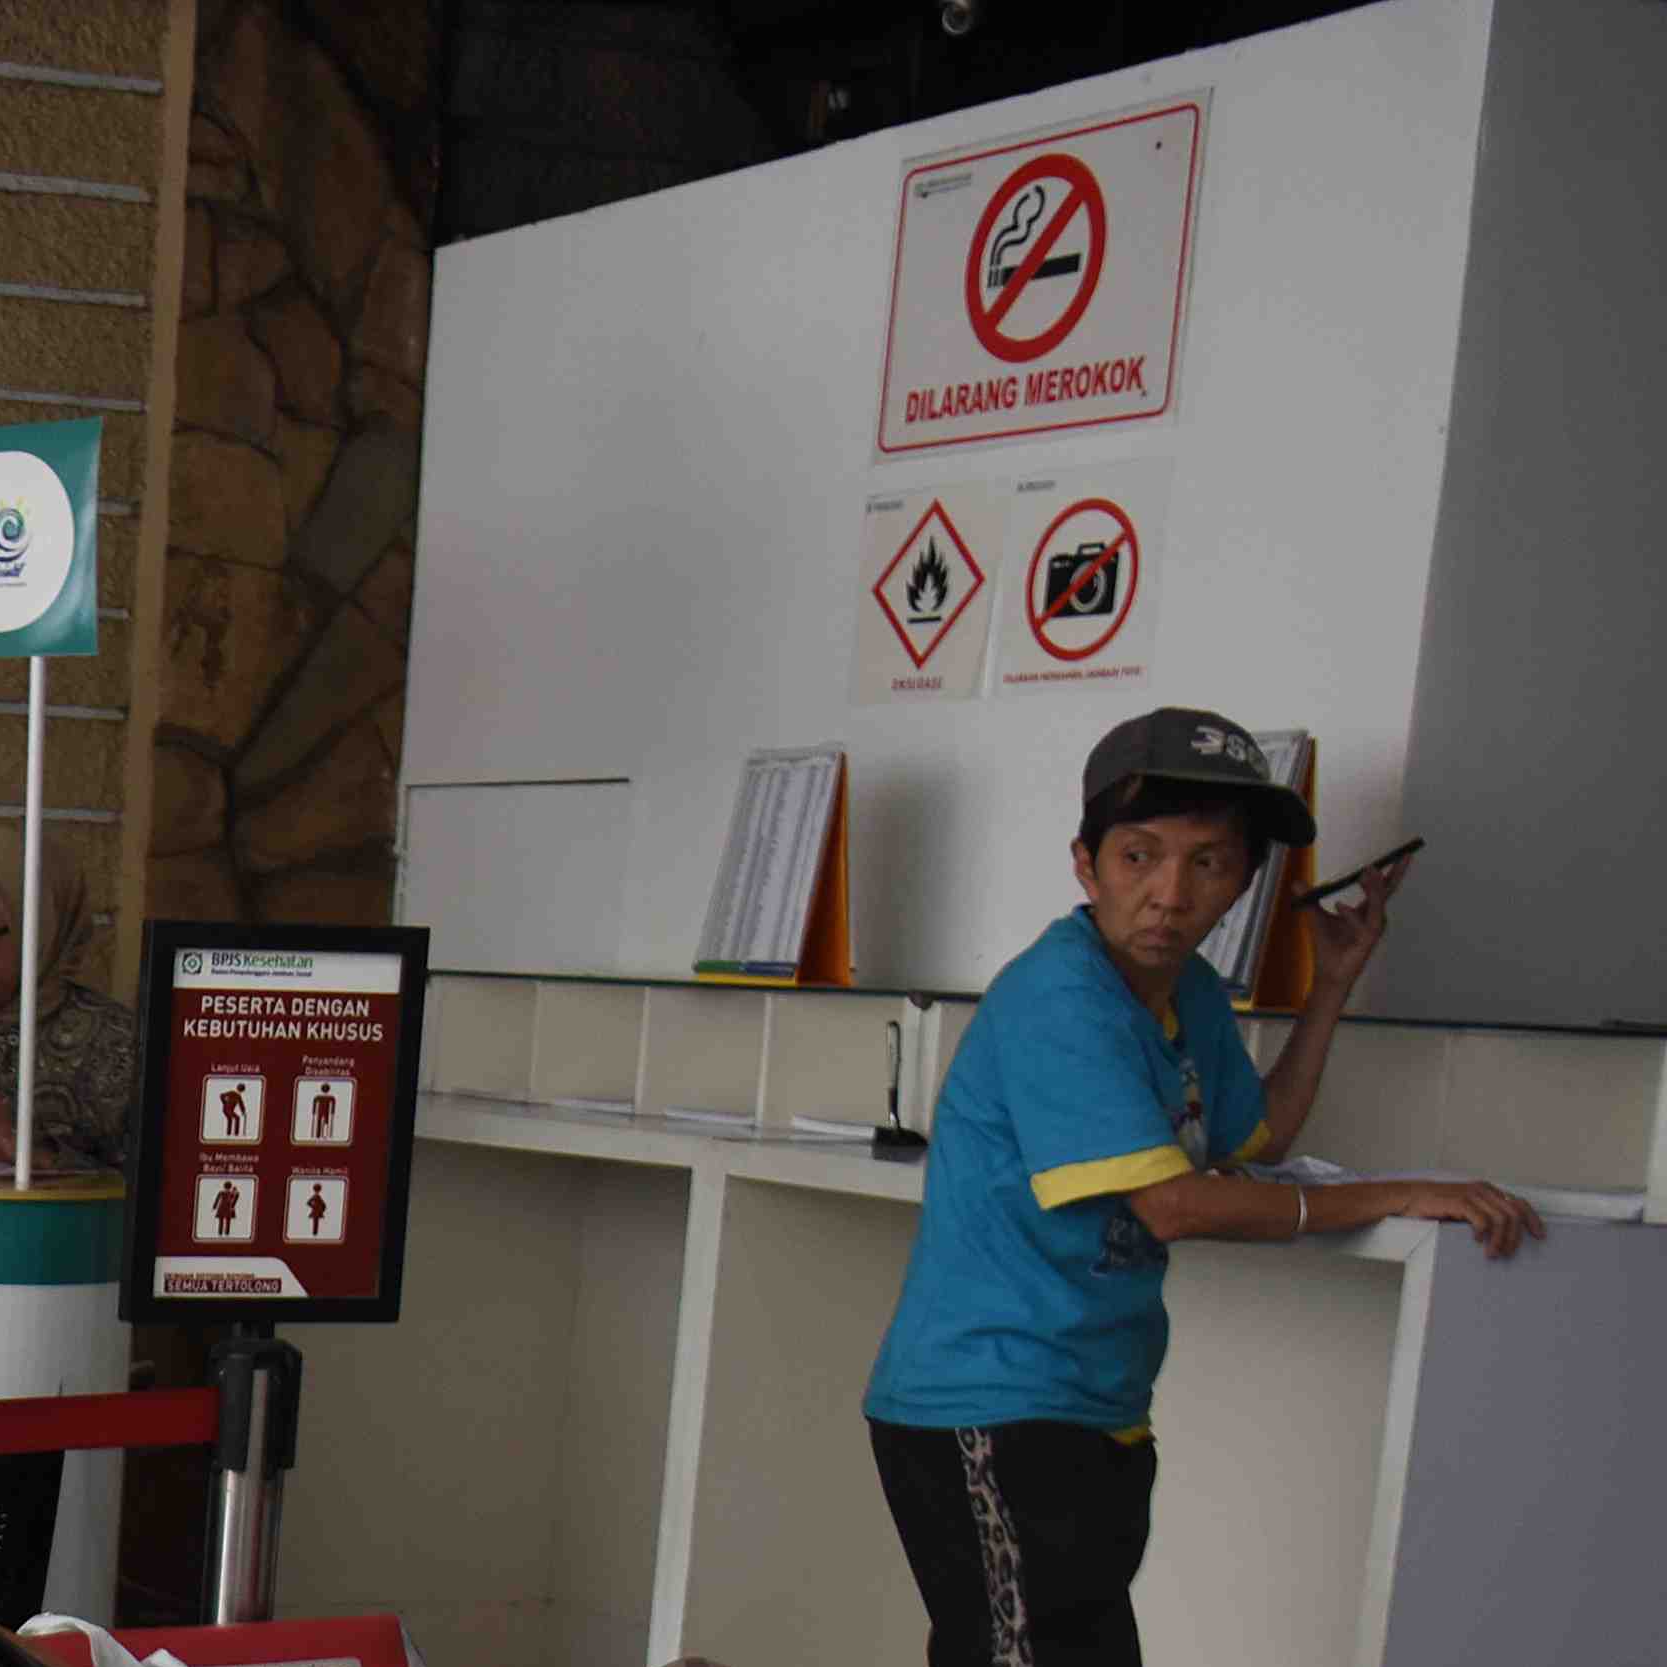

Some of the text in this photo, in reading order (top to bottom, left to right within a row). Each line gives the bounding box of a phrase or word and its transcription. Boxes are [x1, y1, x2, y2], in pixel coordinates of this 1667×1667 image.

[904, 355, 1146, 423] DILARANG MEROKOK
[211, 951, 314, 970] BPJS Kesehatan
[201, 995, 370, 1017] PESERTA DENGAN
[183, 1018, 384, 1042] KEBUTUHAN KHUSUS
